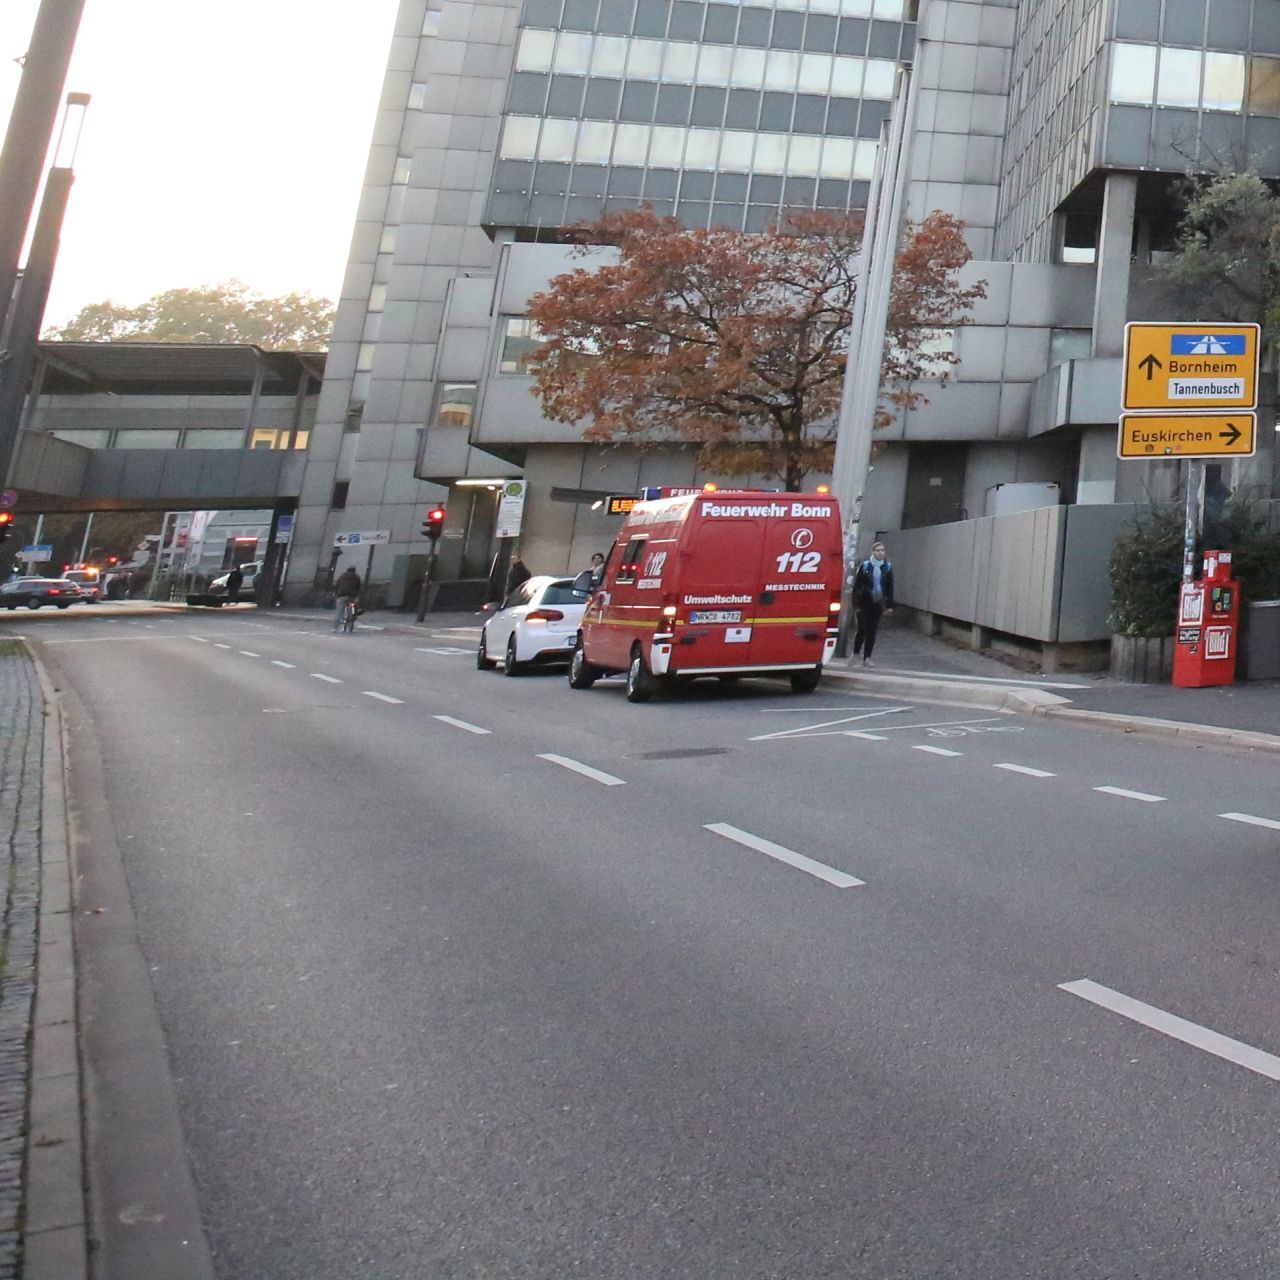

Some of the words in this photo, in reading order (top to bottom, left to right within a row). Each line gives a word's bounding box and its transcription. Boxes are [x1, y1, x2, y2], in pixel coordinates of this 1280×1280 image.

[1169, 361, 1237, 373] Bornheim
[1173, 382, 1240, 395] Tannenbusch
[1132, 430, 1212, 443] Euskirchen
[701, 502, 787, 518] Feuerwehr
[791, 503, 831, 518] Bonn
[776, 551, 822, 573] 112
[765, 583, 826, 591] MESSTECHNIK
[684, 594, 752, 605] Umweltschutz
